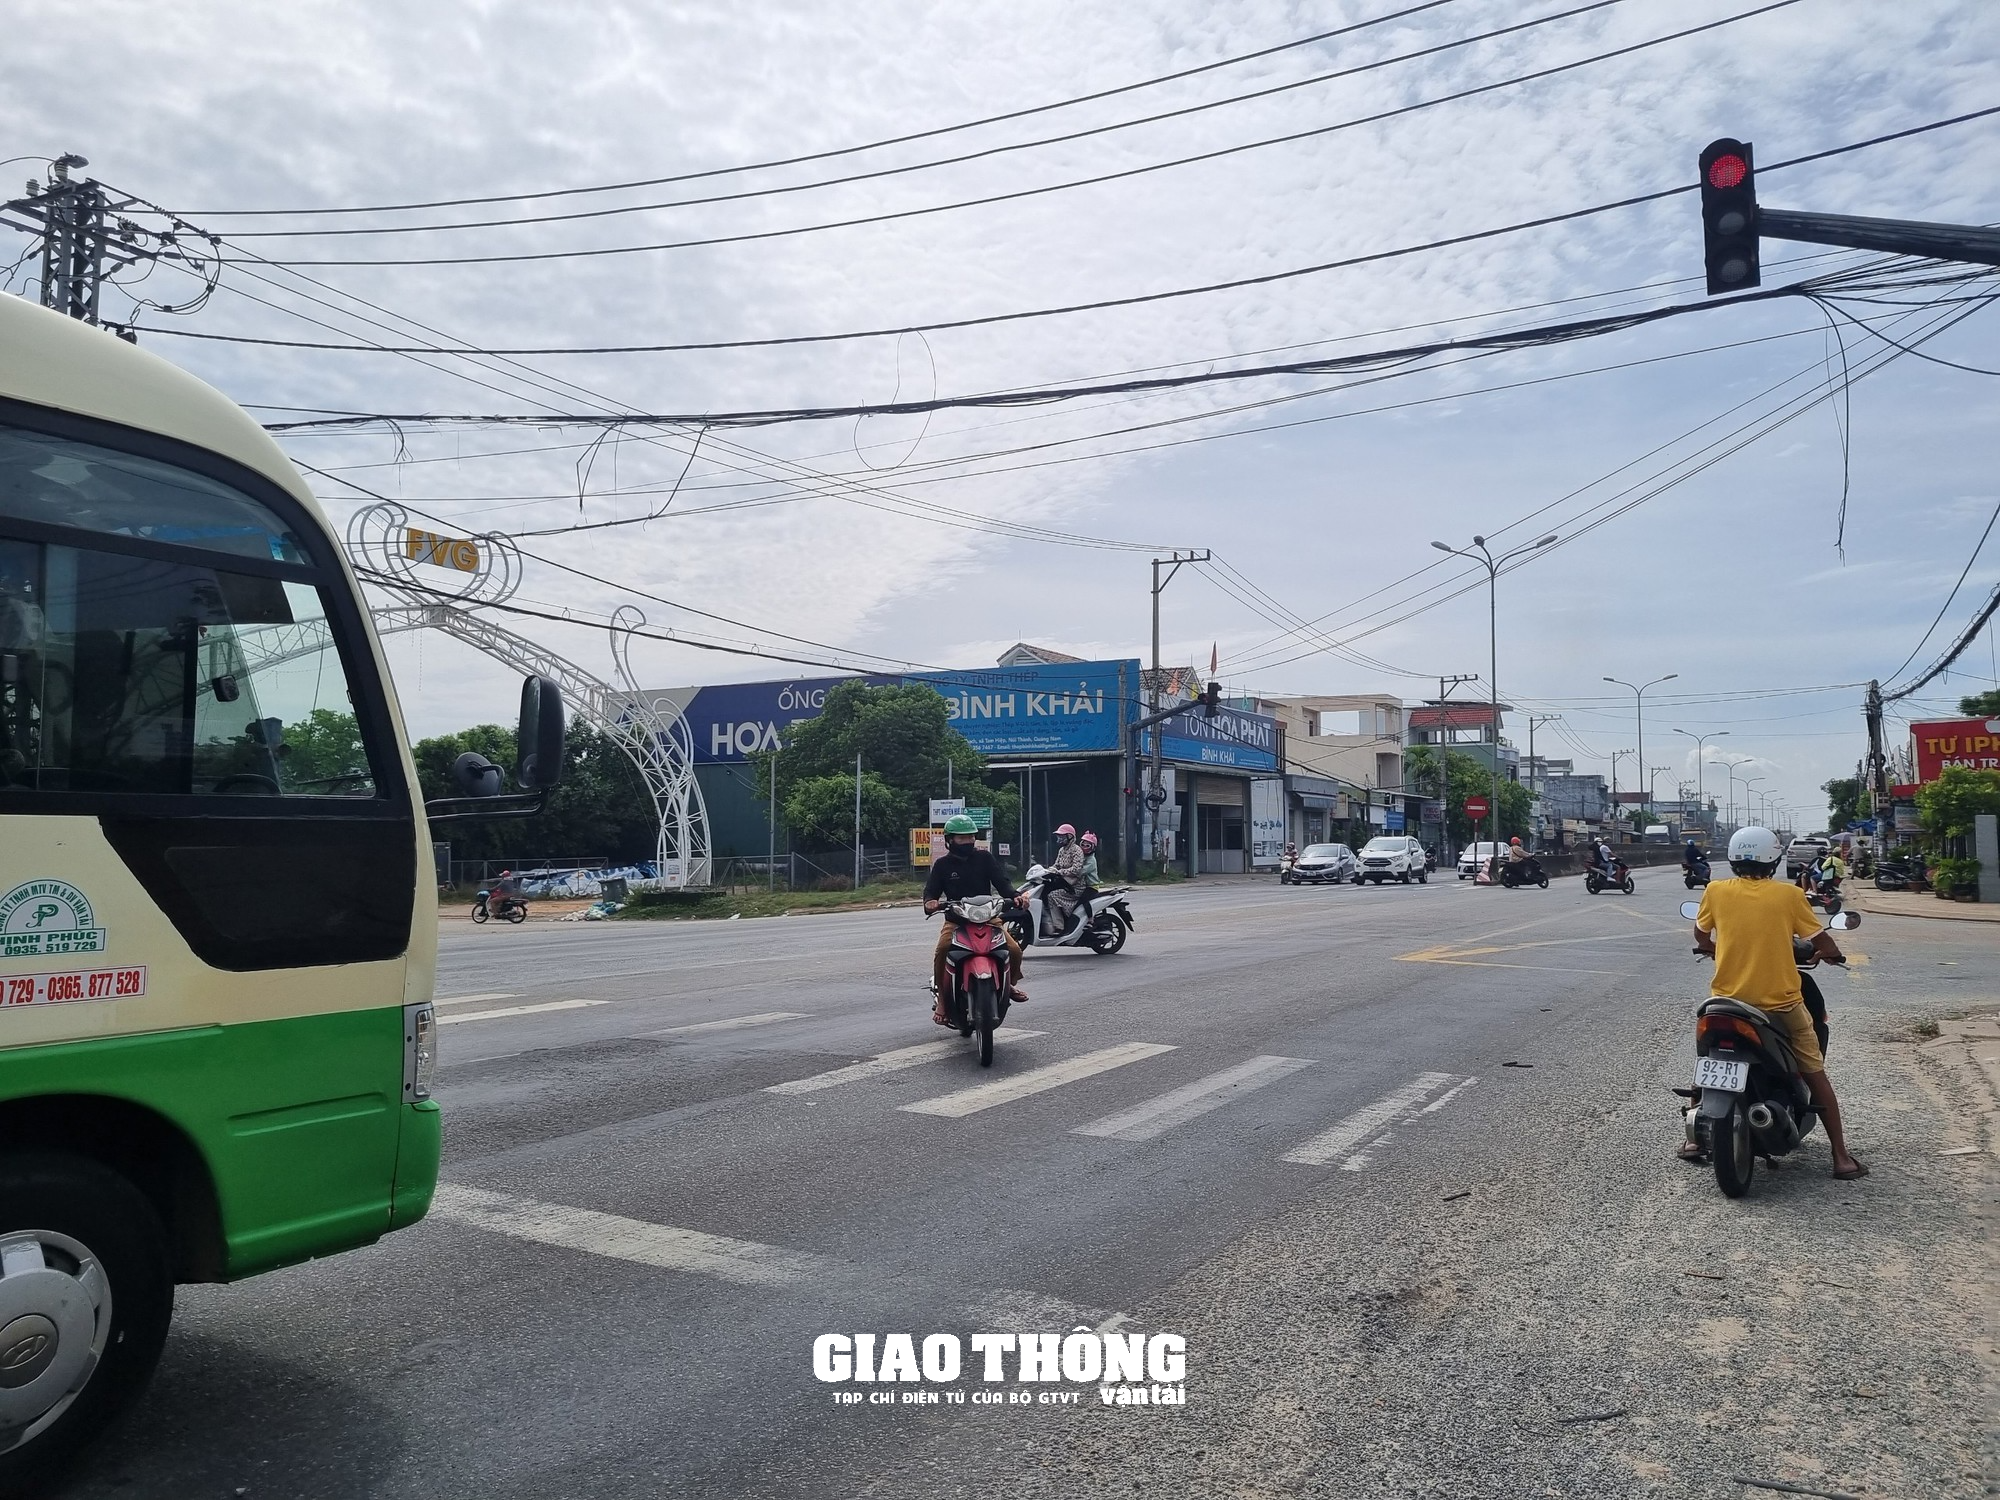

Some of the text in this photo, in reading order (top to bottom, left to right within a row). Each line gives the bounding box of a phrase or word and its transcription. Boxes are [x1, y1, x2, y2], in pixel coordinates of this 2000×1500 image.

[407, 527, 479, 572] FVG
[947, 681, 1103, 720] BÌNH KHẢI
[9, 889, 30, 906] TNHH
[31, 884, 47, 895] MTV
[49, 884, 60, 895] TM
[60, 888, 67, 898] &
[47, 930, 98, 942] PHÚC
[46, 942, 70, 952] 519
[73, 941, 97, 951] 729
[8, 979, 35, 1004] 729
[47, 976, 84, 1001] 0365.
[88, 973, 114, 997] 877
[116, 971, 140, 995] 528
[1703, 1060, 1739, 1076] 92-R1
[1700, 1073, 1738, 1089] 2229
